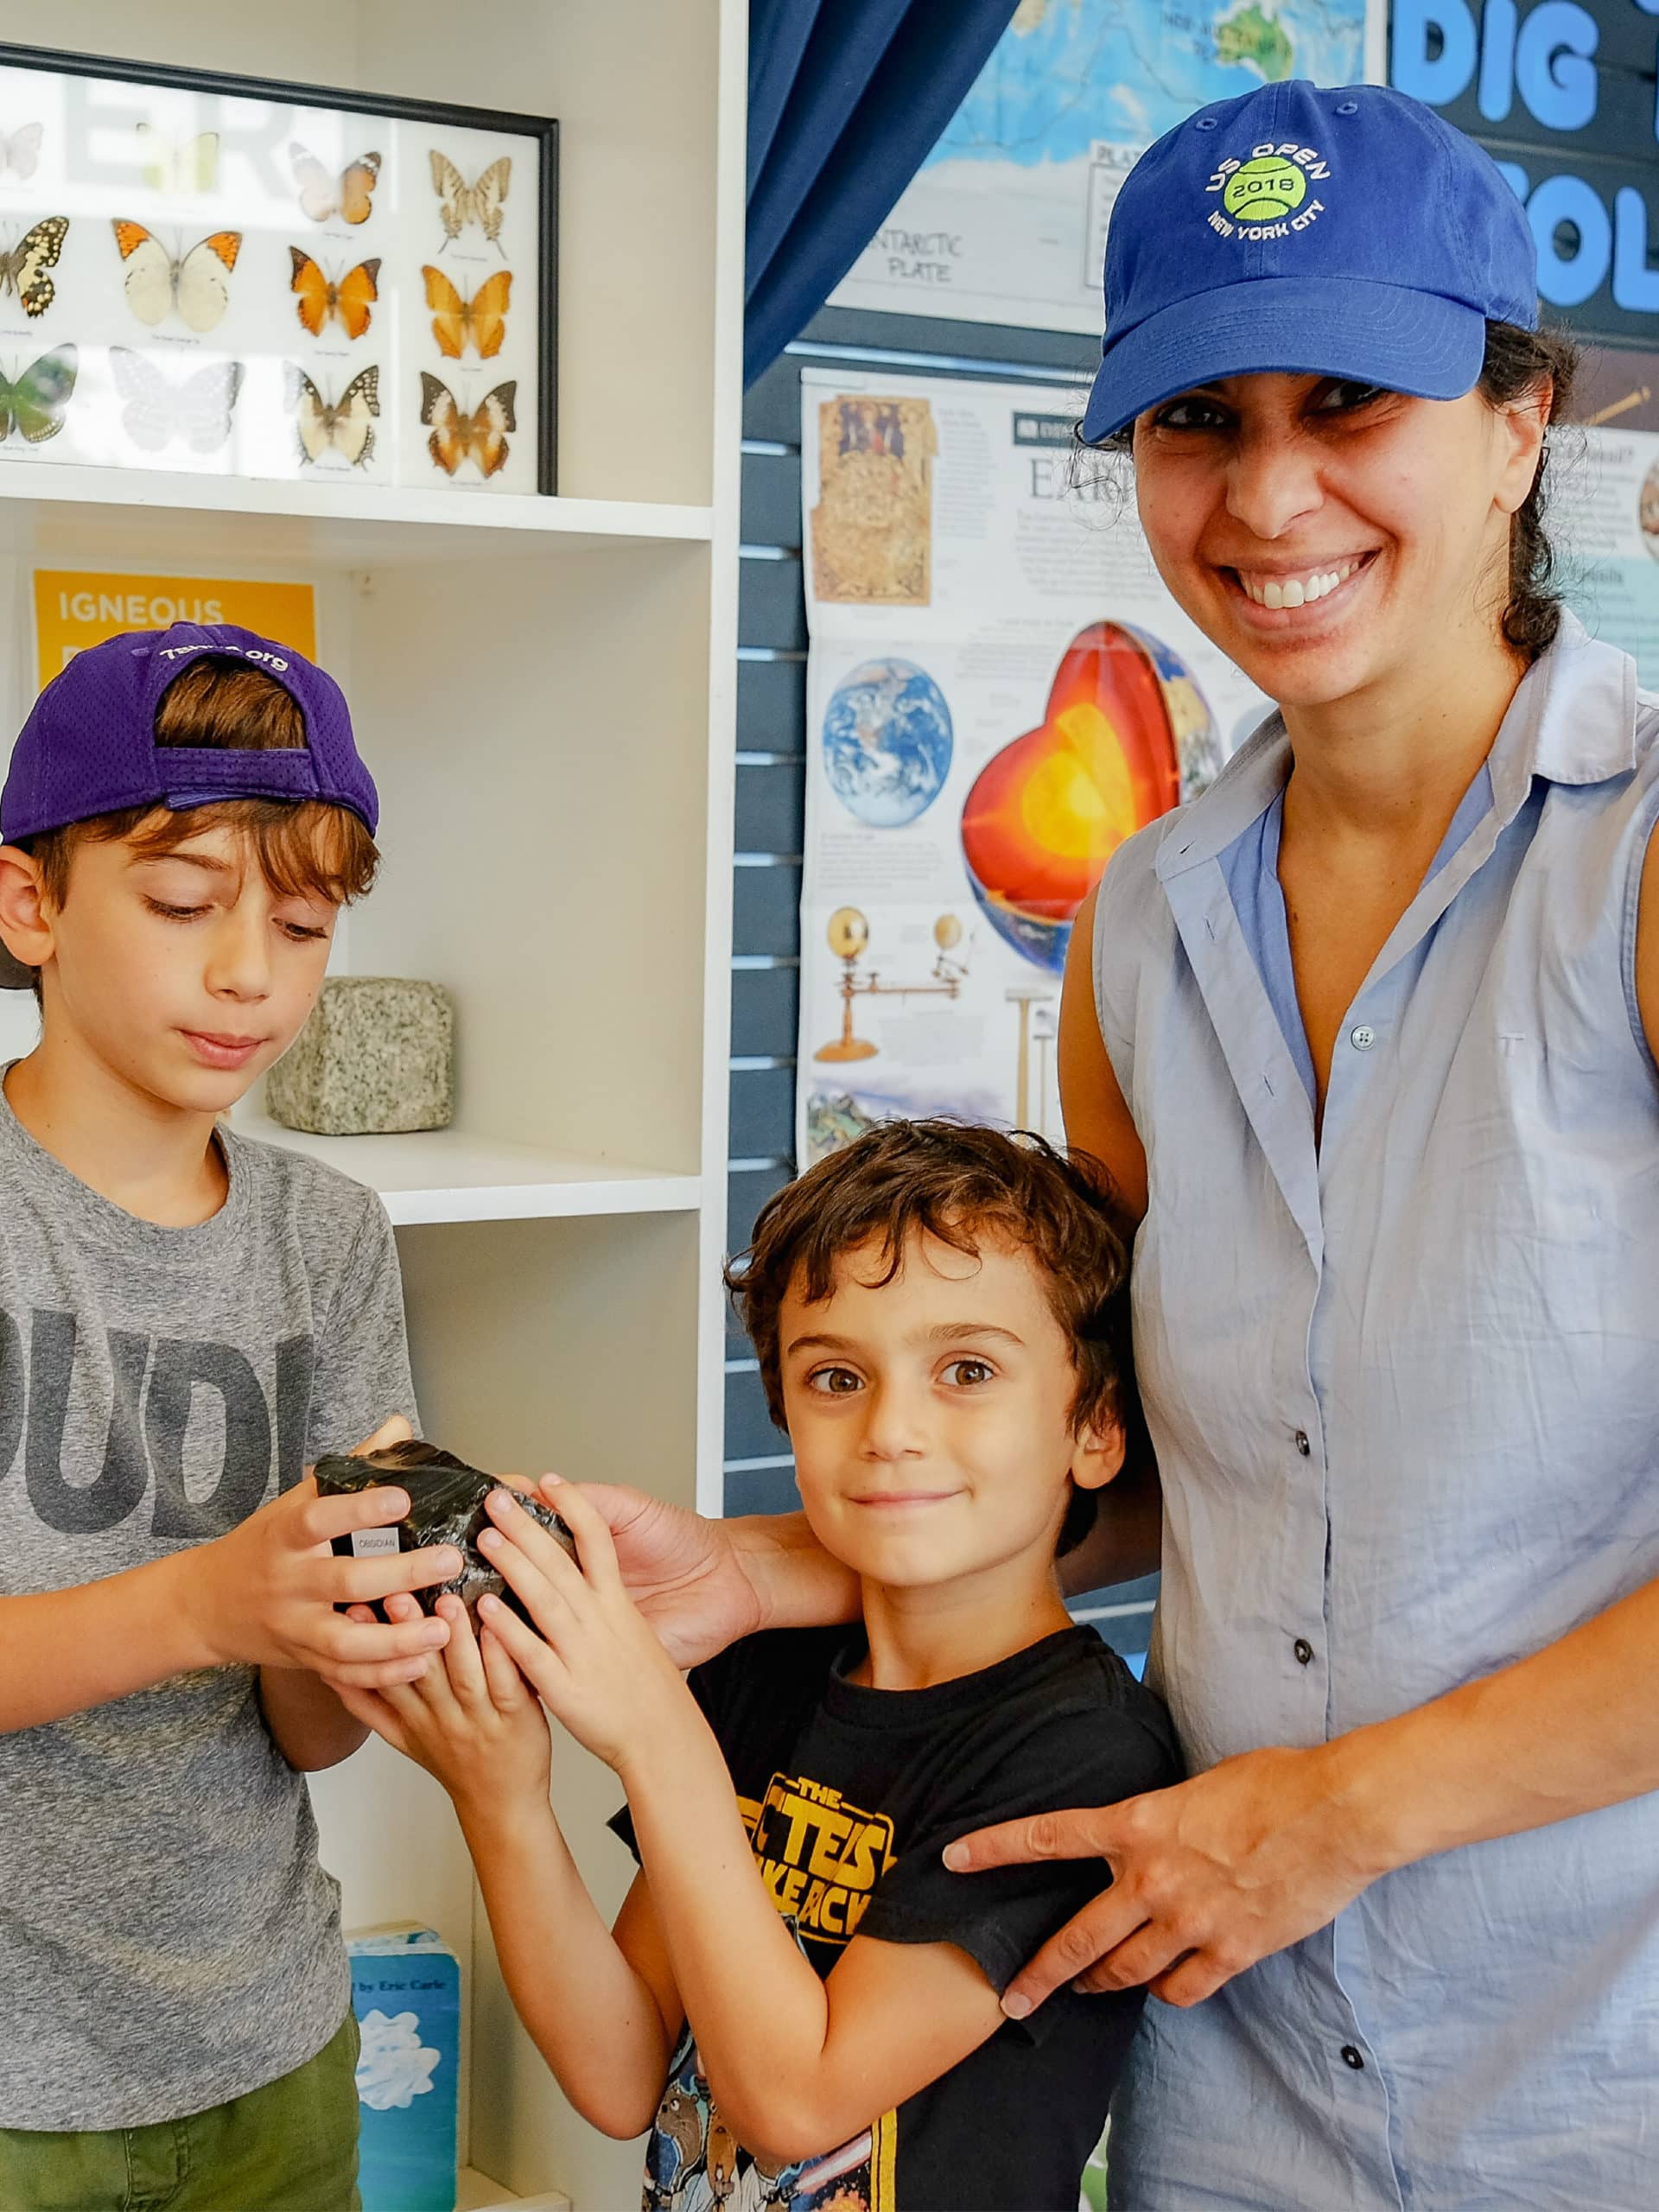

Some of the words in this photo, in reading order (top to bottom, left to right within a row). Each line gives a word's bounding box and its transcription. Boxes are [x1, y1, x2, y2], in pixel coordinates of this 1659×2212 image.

[1392, 0, 1599, 130] DIG
[1205, 158, 1241, 191] US
[1252, 143, 1331, 180] OPEN
[1232, 178, 1294, 198] 2018
[1207, 210, 1235, 238] NEW
[1237, 222, 1290, 241] YORK
[1291, 200, 1325, 231] CITY
[871, 228, 963, 257] NTARCTIC
[887, 257, 952, 283] PLATE
[59, 592, 225, 625] IGNEOUS
[359, 1539, 395, 1548] OBSIDIAN
[798, 1776, 842, 1809] THE
[359, 1981, 374, 1994] by
[379, 1980, 405, 1991] Eric
[410, 1979, 447, 1990] Carle
